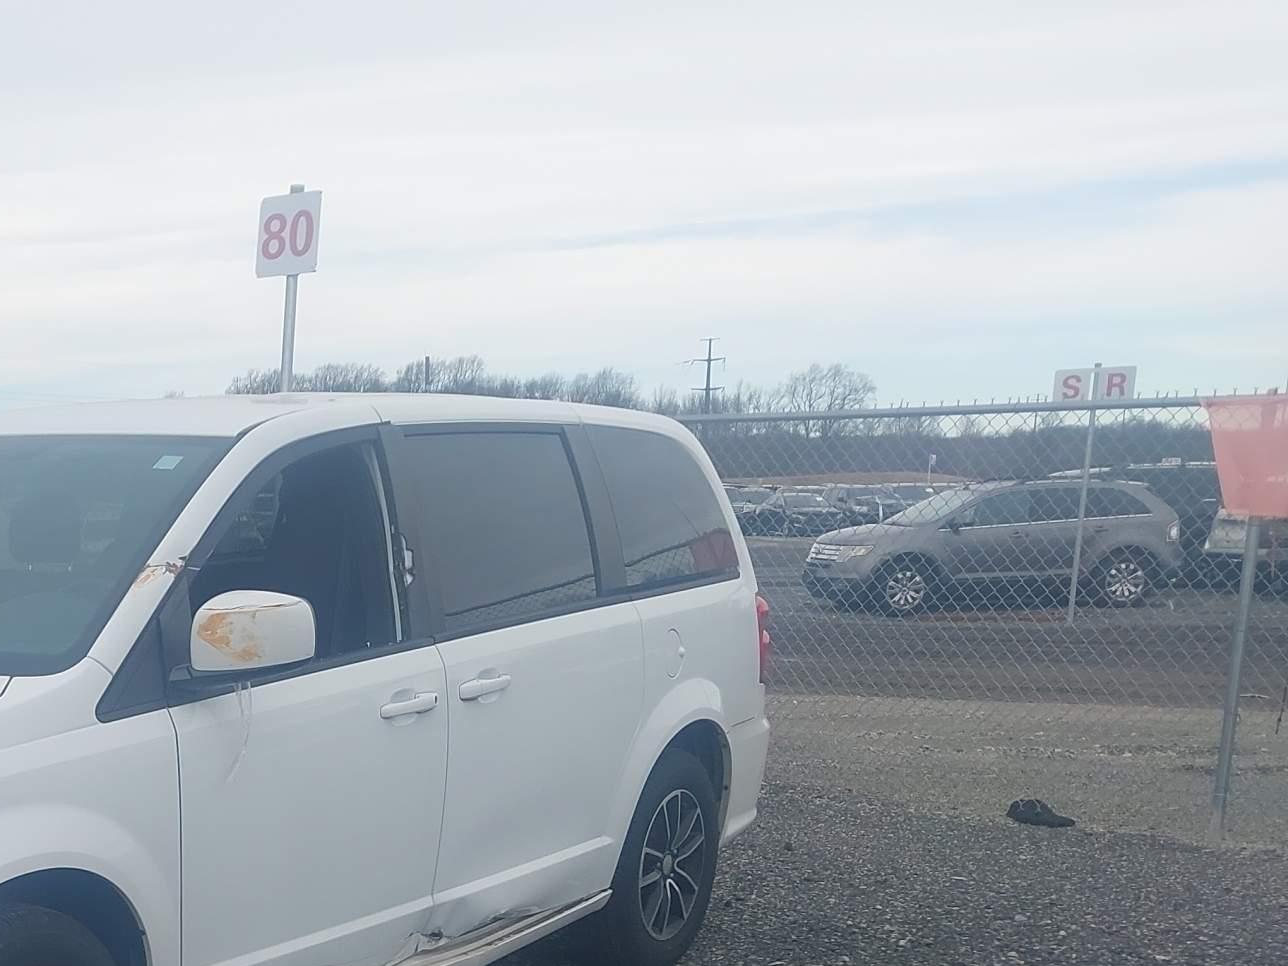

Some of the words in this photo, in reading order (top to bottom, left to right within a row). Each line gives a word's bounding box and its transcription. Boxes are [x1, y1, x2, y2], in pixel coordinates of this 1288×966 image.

[262, 208, 314, 261] 80
[1062, 374, 1083, 399] S
[1106, 372, 1128, 397] R
